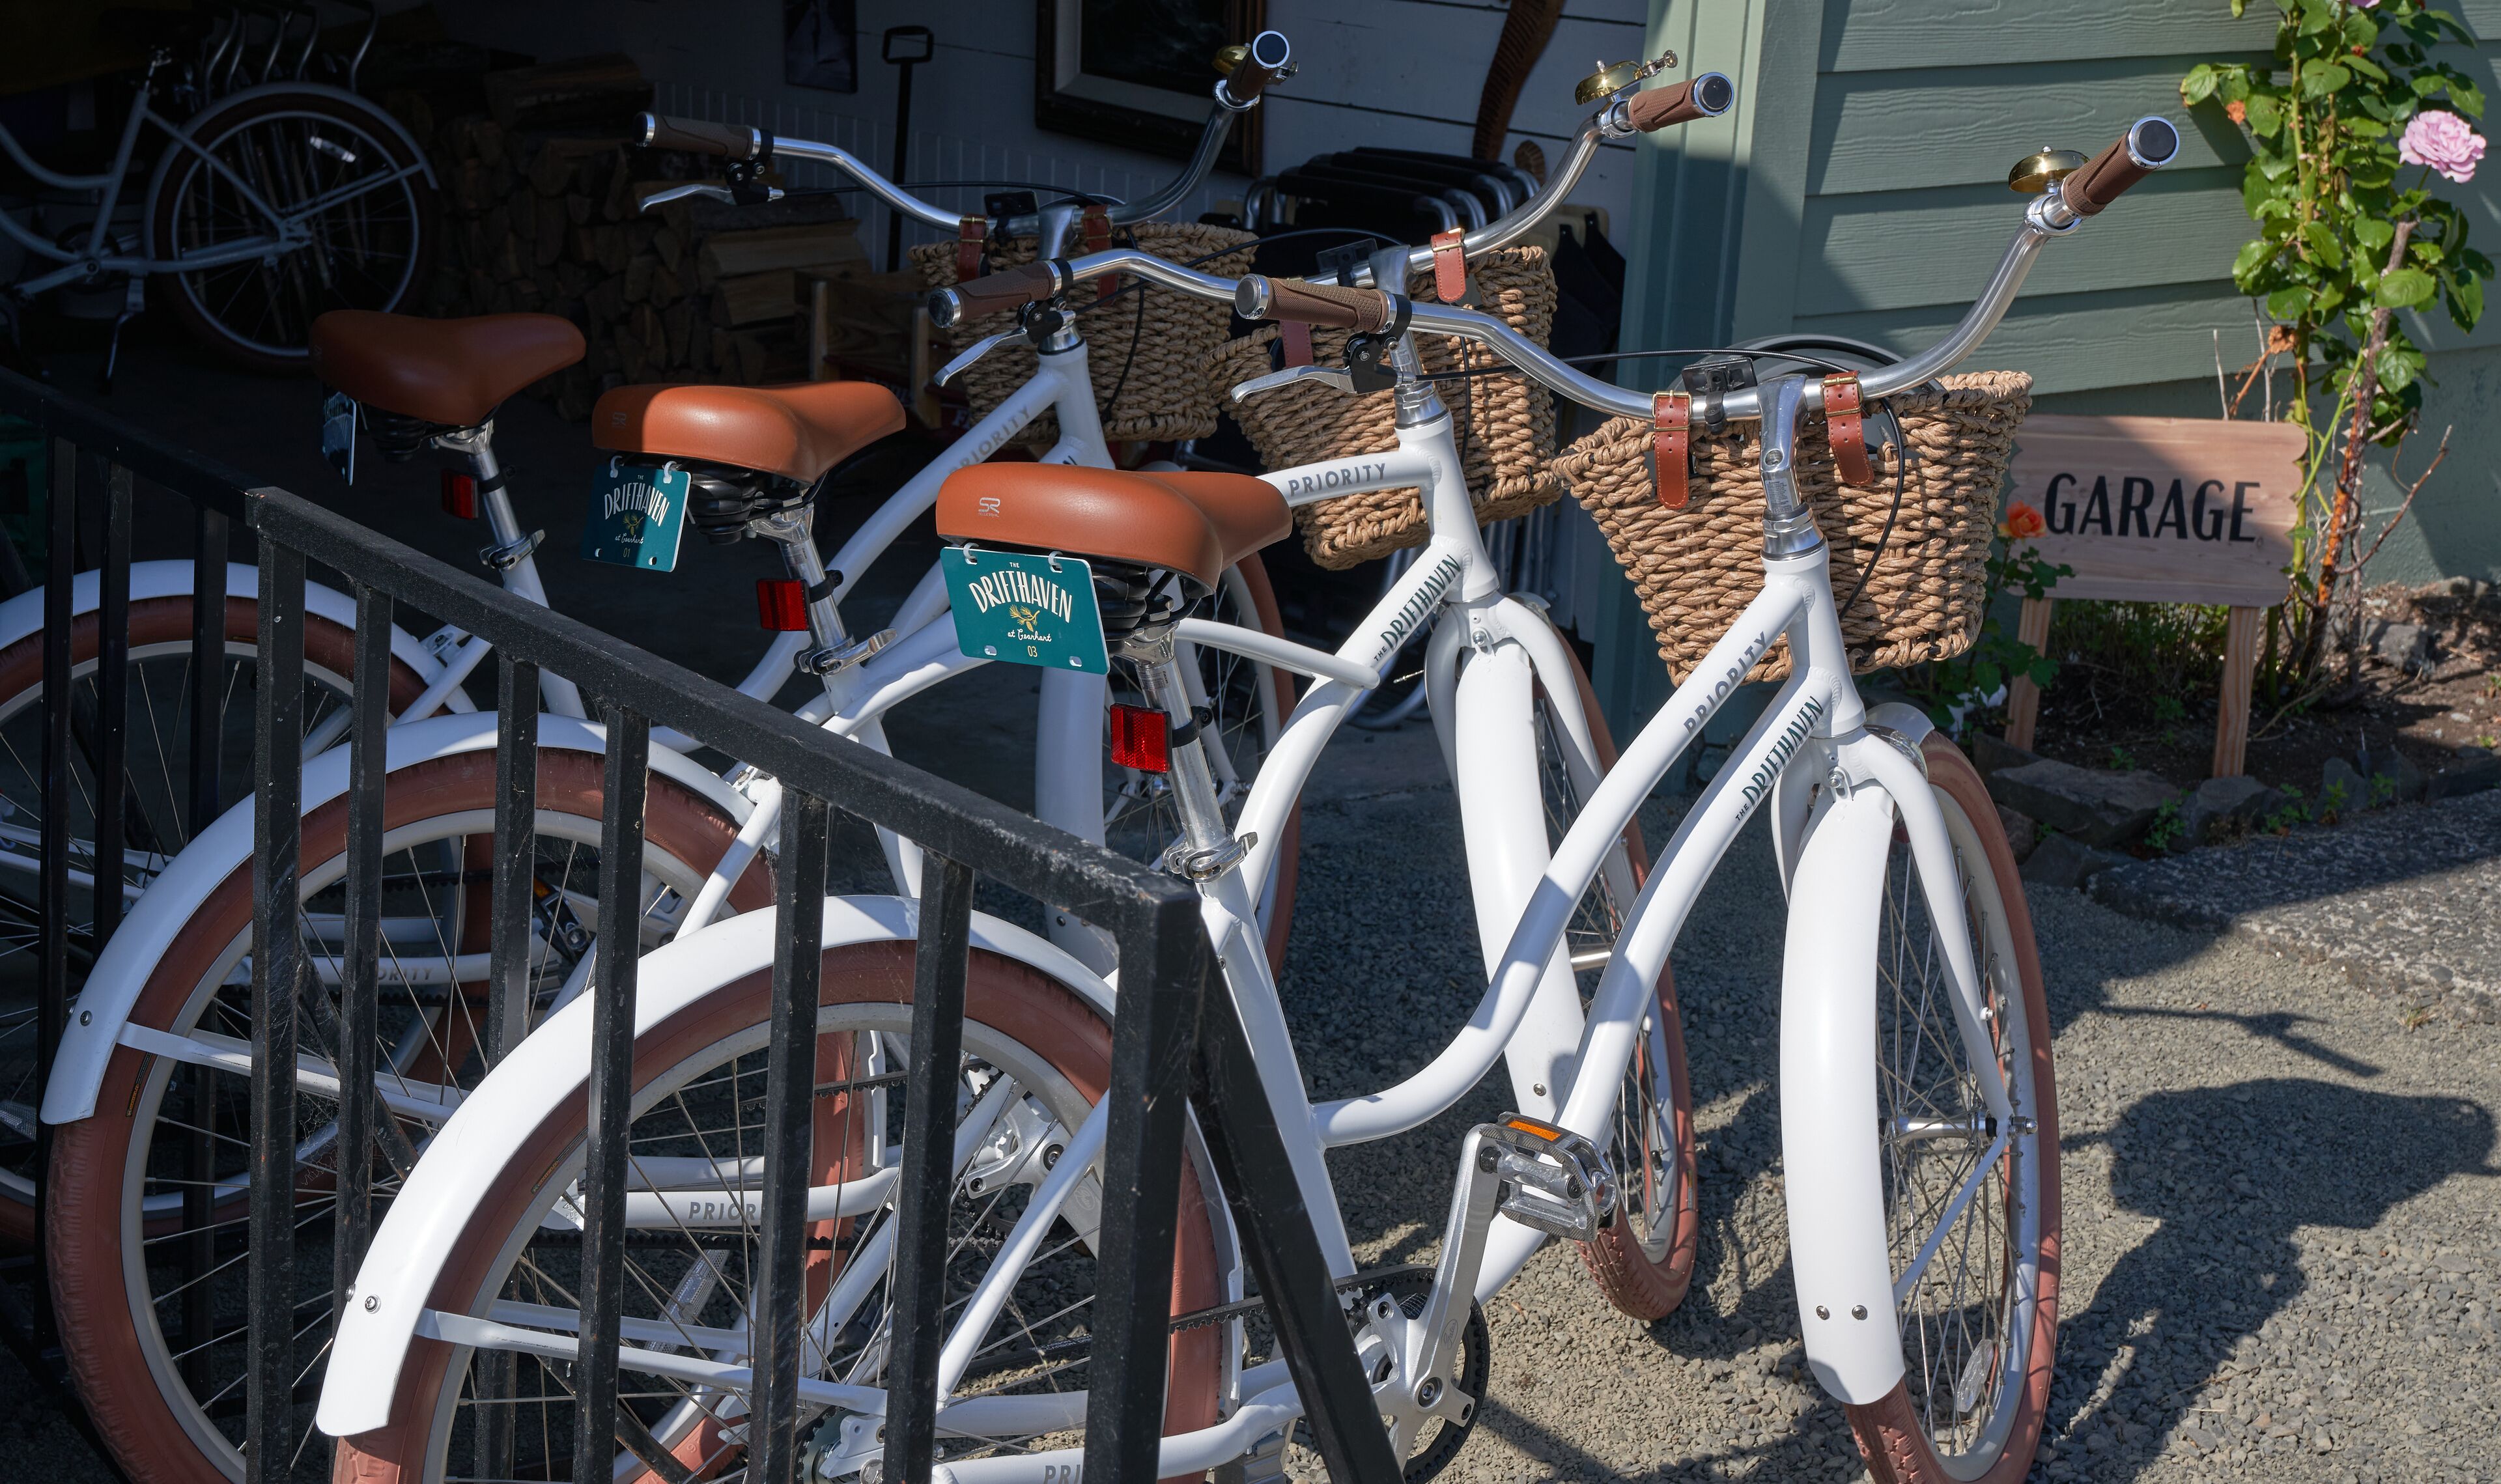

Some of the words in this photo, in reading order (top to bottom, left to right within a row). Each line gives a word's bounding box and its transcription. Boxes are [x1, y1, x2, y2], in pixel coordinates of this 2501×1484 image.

[1288, 462, 1386, 497] PRIORITY
[604, 482, 670, 527] DRIFTHAVEN
[2044, 473, 2261, 542] GARAGE
[621, 533, 644, 544] Gearhart
[623, 548, 631, 558] 01
[968, 570, 1073, 623] DRIFTHAVEN
[1380, 554, 1462, 652] DRIFTHAVEN
[1008, 630, 1016, 639] at
[1017, 628, 1053, 643] Gearhart
[1028, 646, 1038, 658] 03
[1374, 645, 1388, 662] THE
[1683, 631, 1768, 736] PRIORITY
[1742, 695, 1824, 809] DRIFTHAVEN
[1735, 804, 1750, 822] THE
[378, 968, 432, 981] ORITY
[688, 1201, 756, 1220] PRIOR
